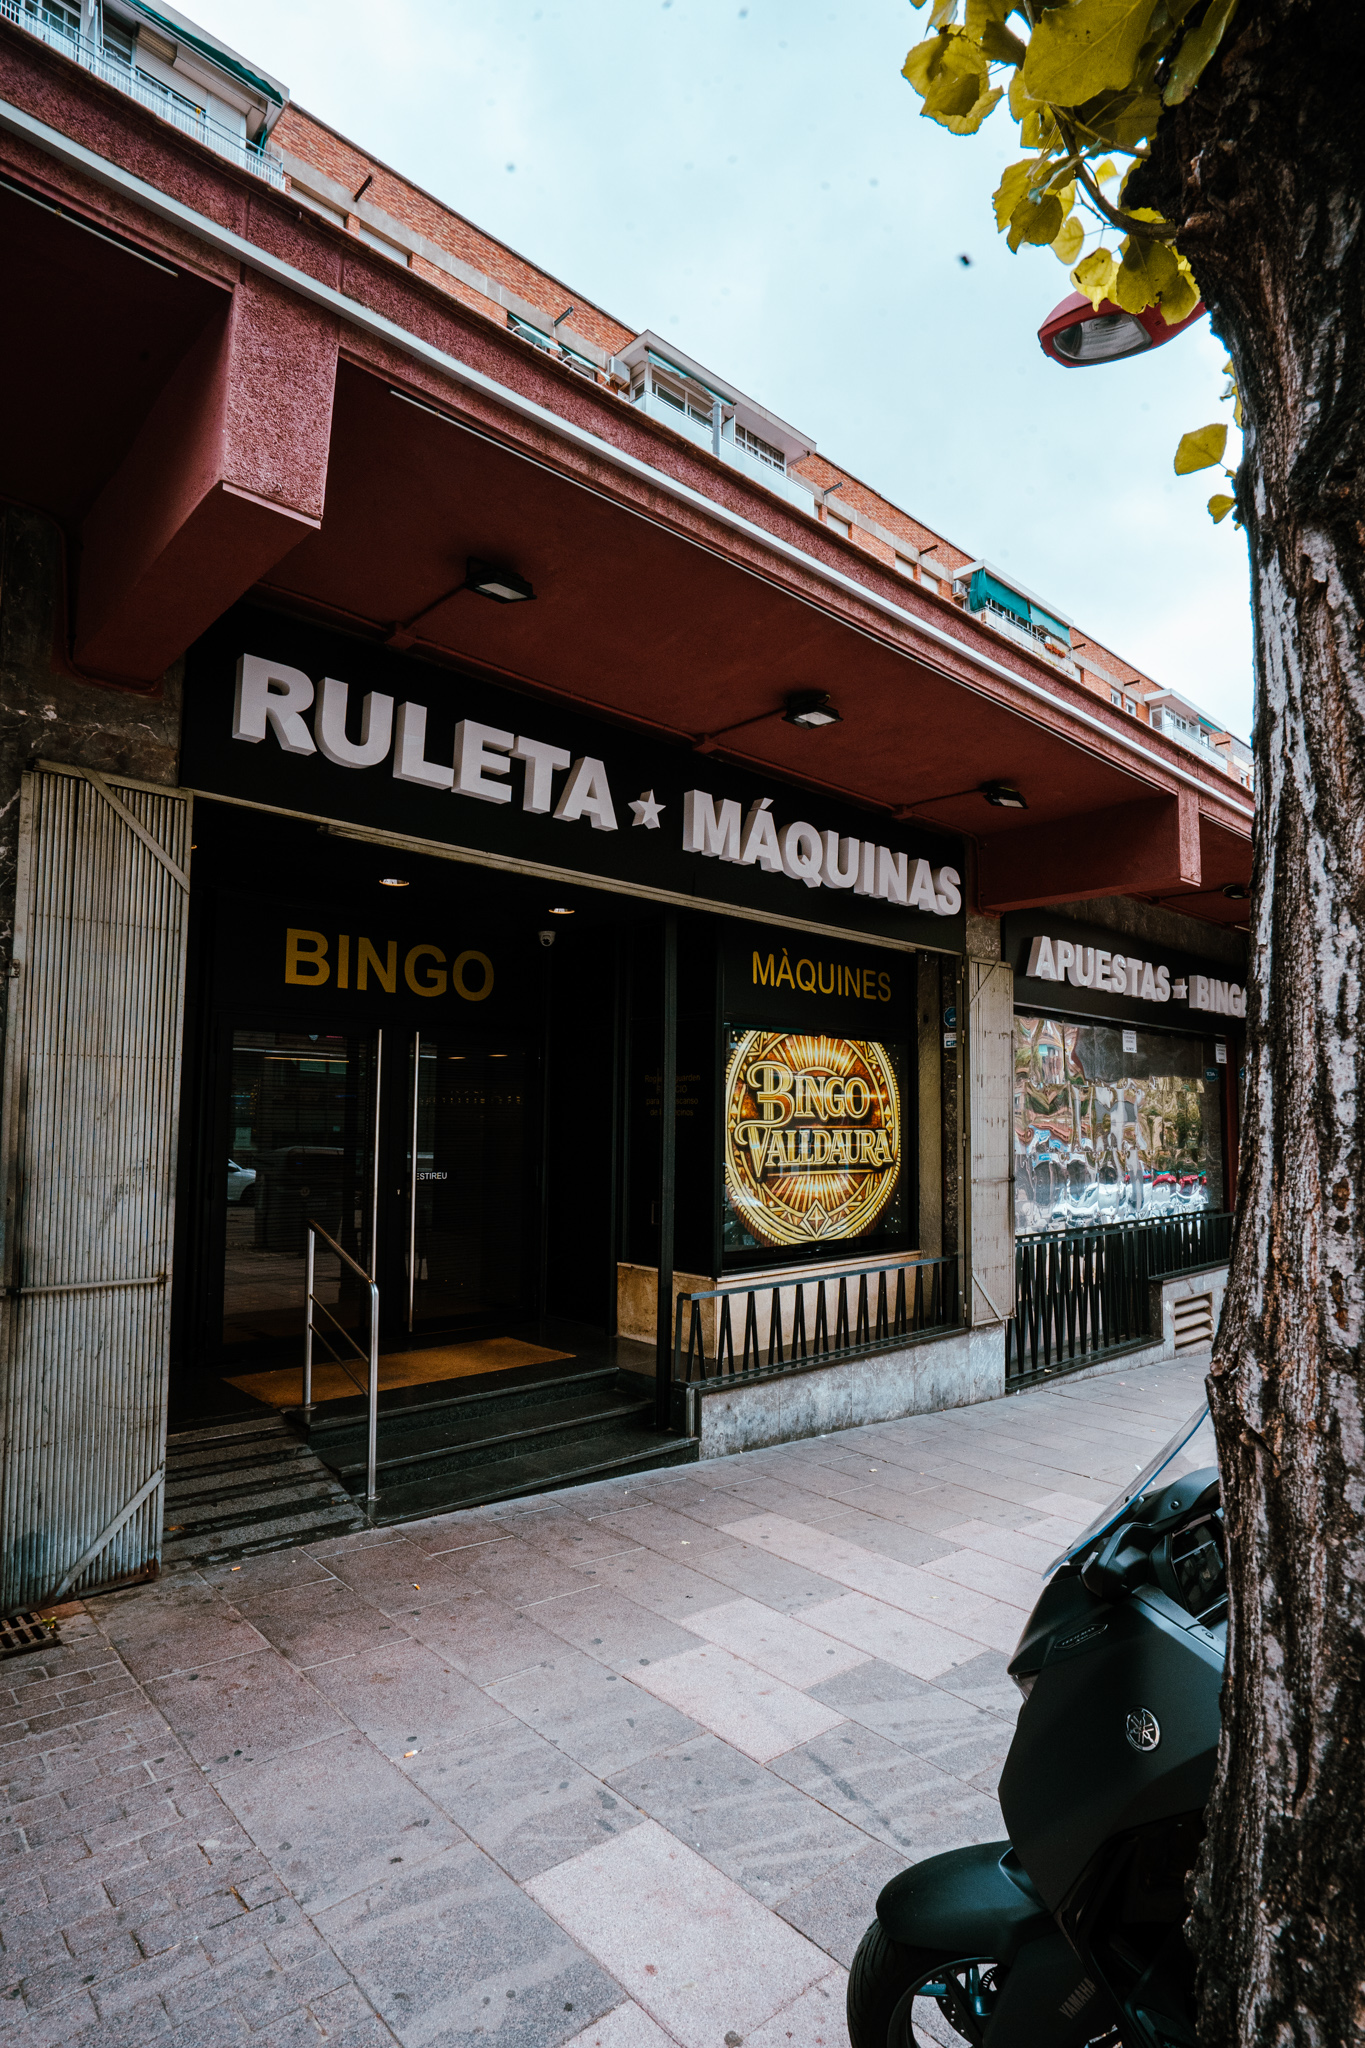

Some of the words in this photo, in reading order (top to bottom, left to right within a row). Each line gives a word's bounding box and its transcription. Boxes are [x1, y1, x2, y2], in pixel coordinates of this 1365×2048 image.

[232, 653, 618, 831] RULETA
[683, 789, 962, 916] MÁQUINAS
[285, 927, 495, 1002] BINGO
[752, 947, 892, 1002] MÀQUINES
[1026, 935, 1171, 1002] APUESTAS
[746, 1060, 871, 1123] BINGO
[416, 1171, 448, 1181] ESTIREU
[734, 1120, 895, 1178] VALLDAURA
[1058, 1977, 1097, 2020] YAMAHA
